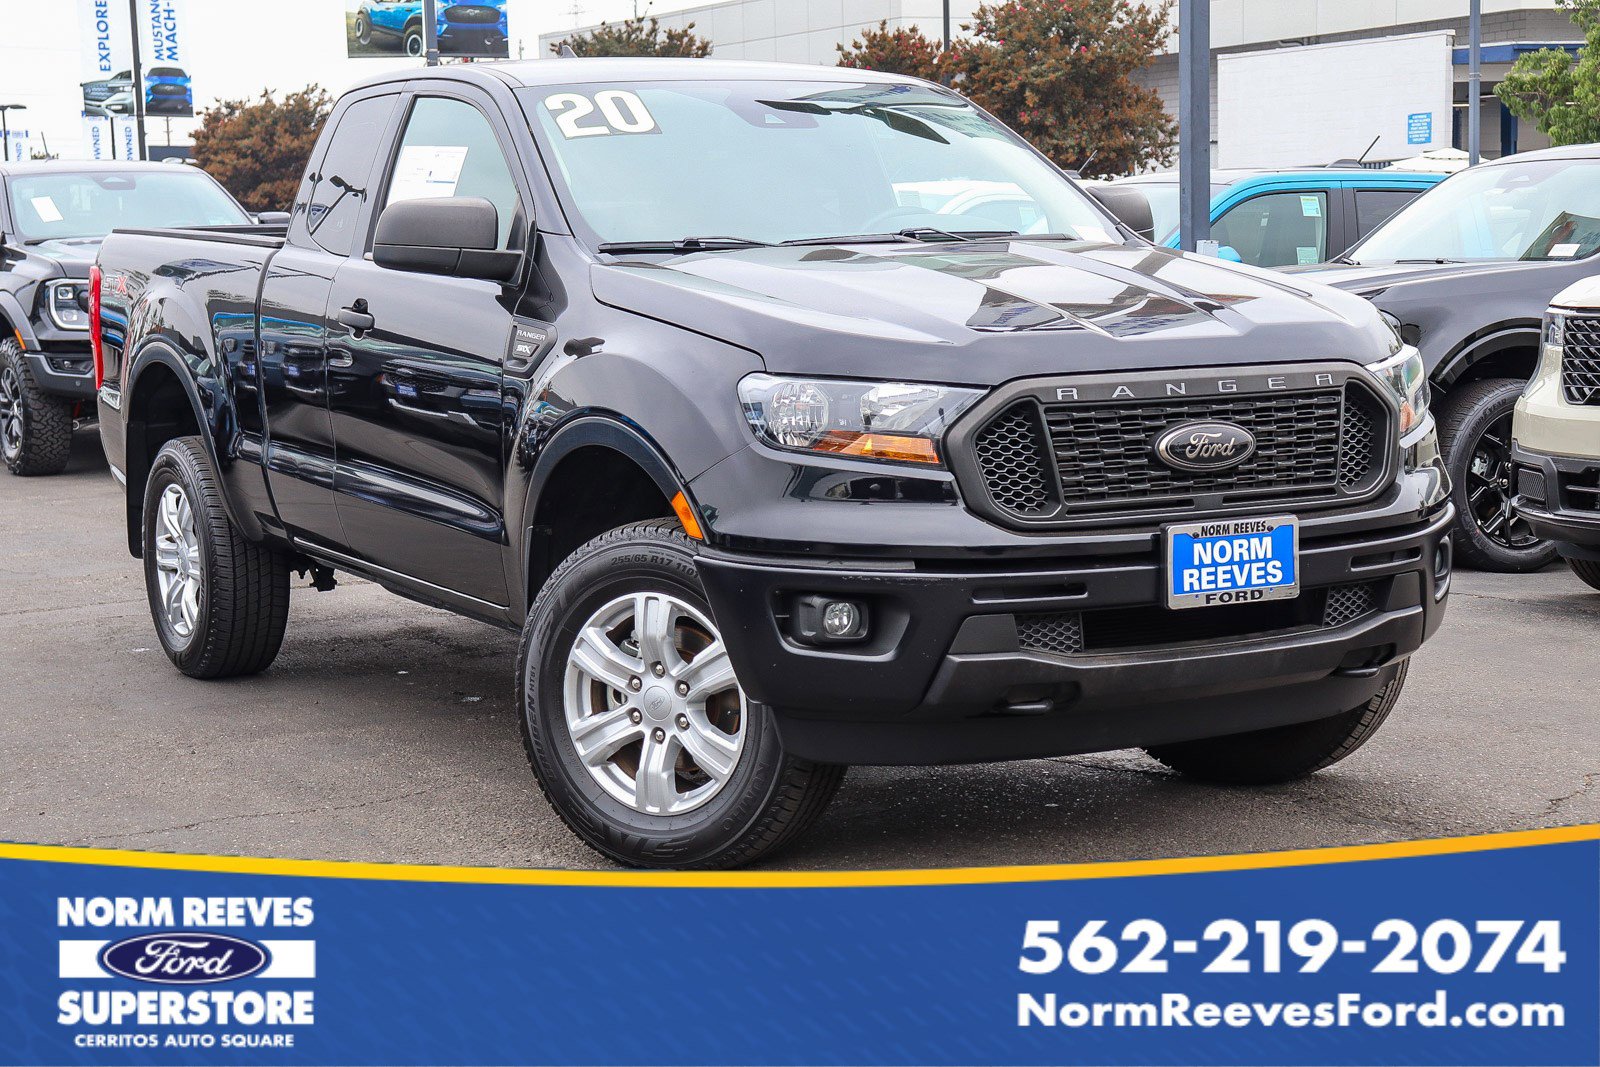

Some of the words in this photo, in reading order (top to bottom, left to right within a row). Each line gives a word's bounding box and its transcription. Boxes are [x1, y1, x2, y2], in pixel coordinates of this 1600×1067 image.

[95, 0, 112, 71] EXPLORE
[150, 0, 165, 61] MUSTAN
[544, 90, 656, 139] 20
[102, 275, 128, 296] STX
[516, 329, 546, 341] RANGER
[1056, 373, 1334, 401] RANGER
[1185, 432, 1236, 459] Ford
[1200, 523, 1231, 537] NORM
[1233, 520, 1267, 534] REEVES
[611, 553, 648, 566] 255/65
[650, 555, 674, 567] R17
[1193, 536, 1273, 566] NORM
[1183, 560, 1283, 592] REEVES
[1205, 589, 1264, 605] FORD
